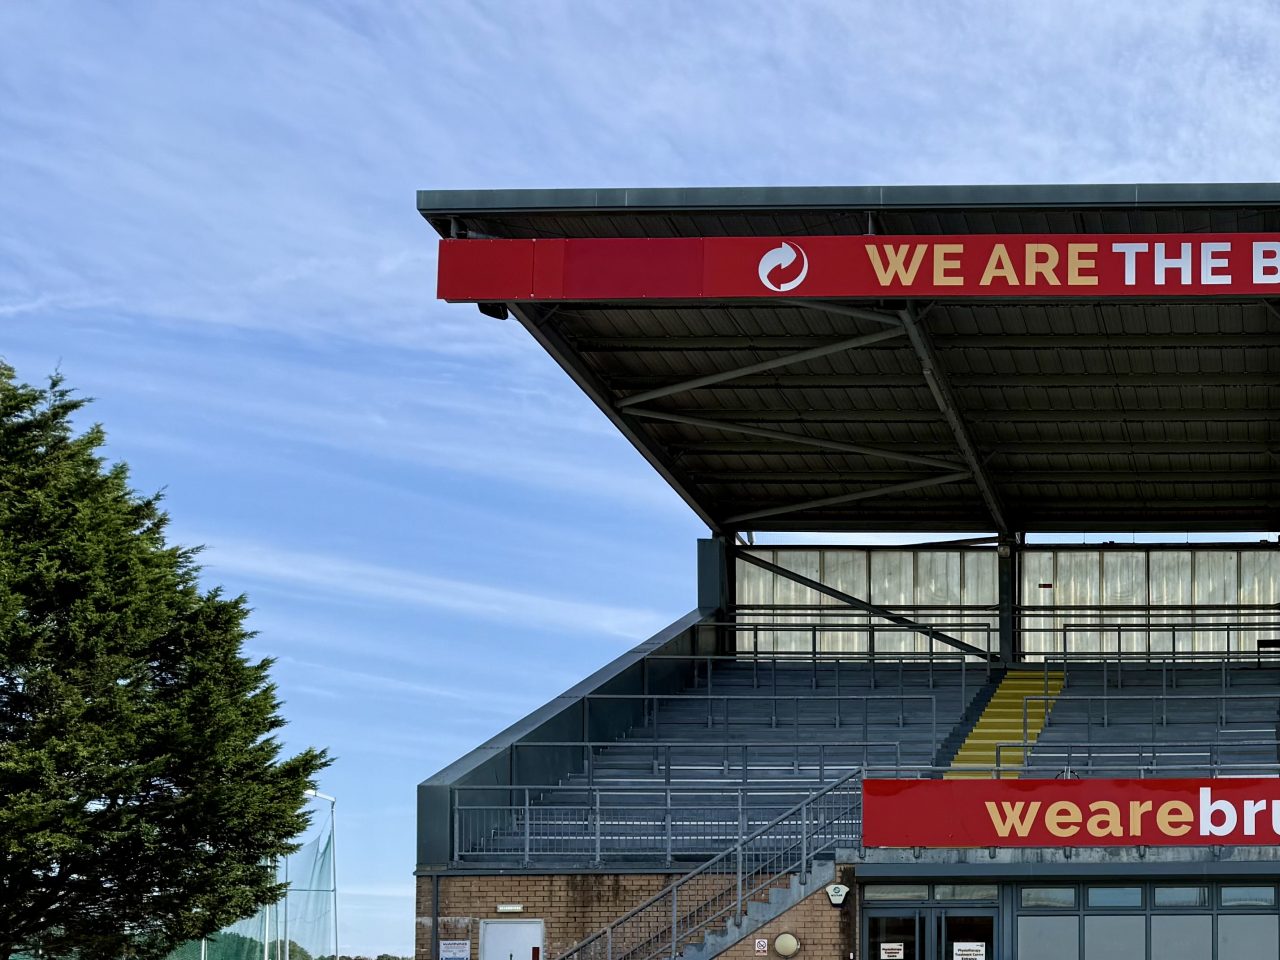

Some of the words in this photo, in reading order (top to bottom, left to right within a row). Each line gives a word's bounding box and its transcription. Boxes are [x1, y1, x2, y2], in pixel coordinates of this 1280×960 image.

[865, 243, 964, 286] WE
[979, 243, 1099, 286] ARE
[1112, 242, 1232, 285] THE
